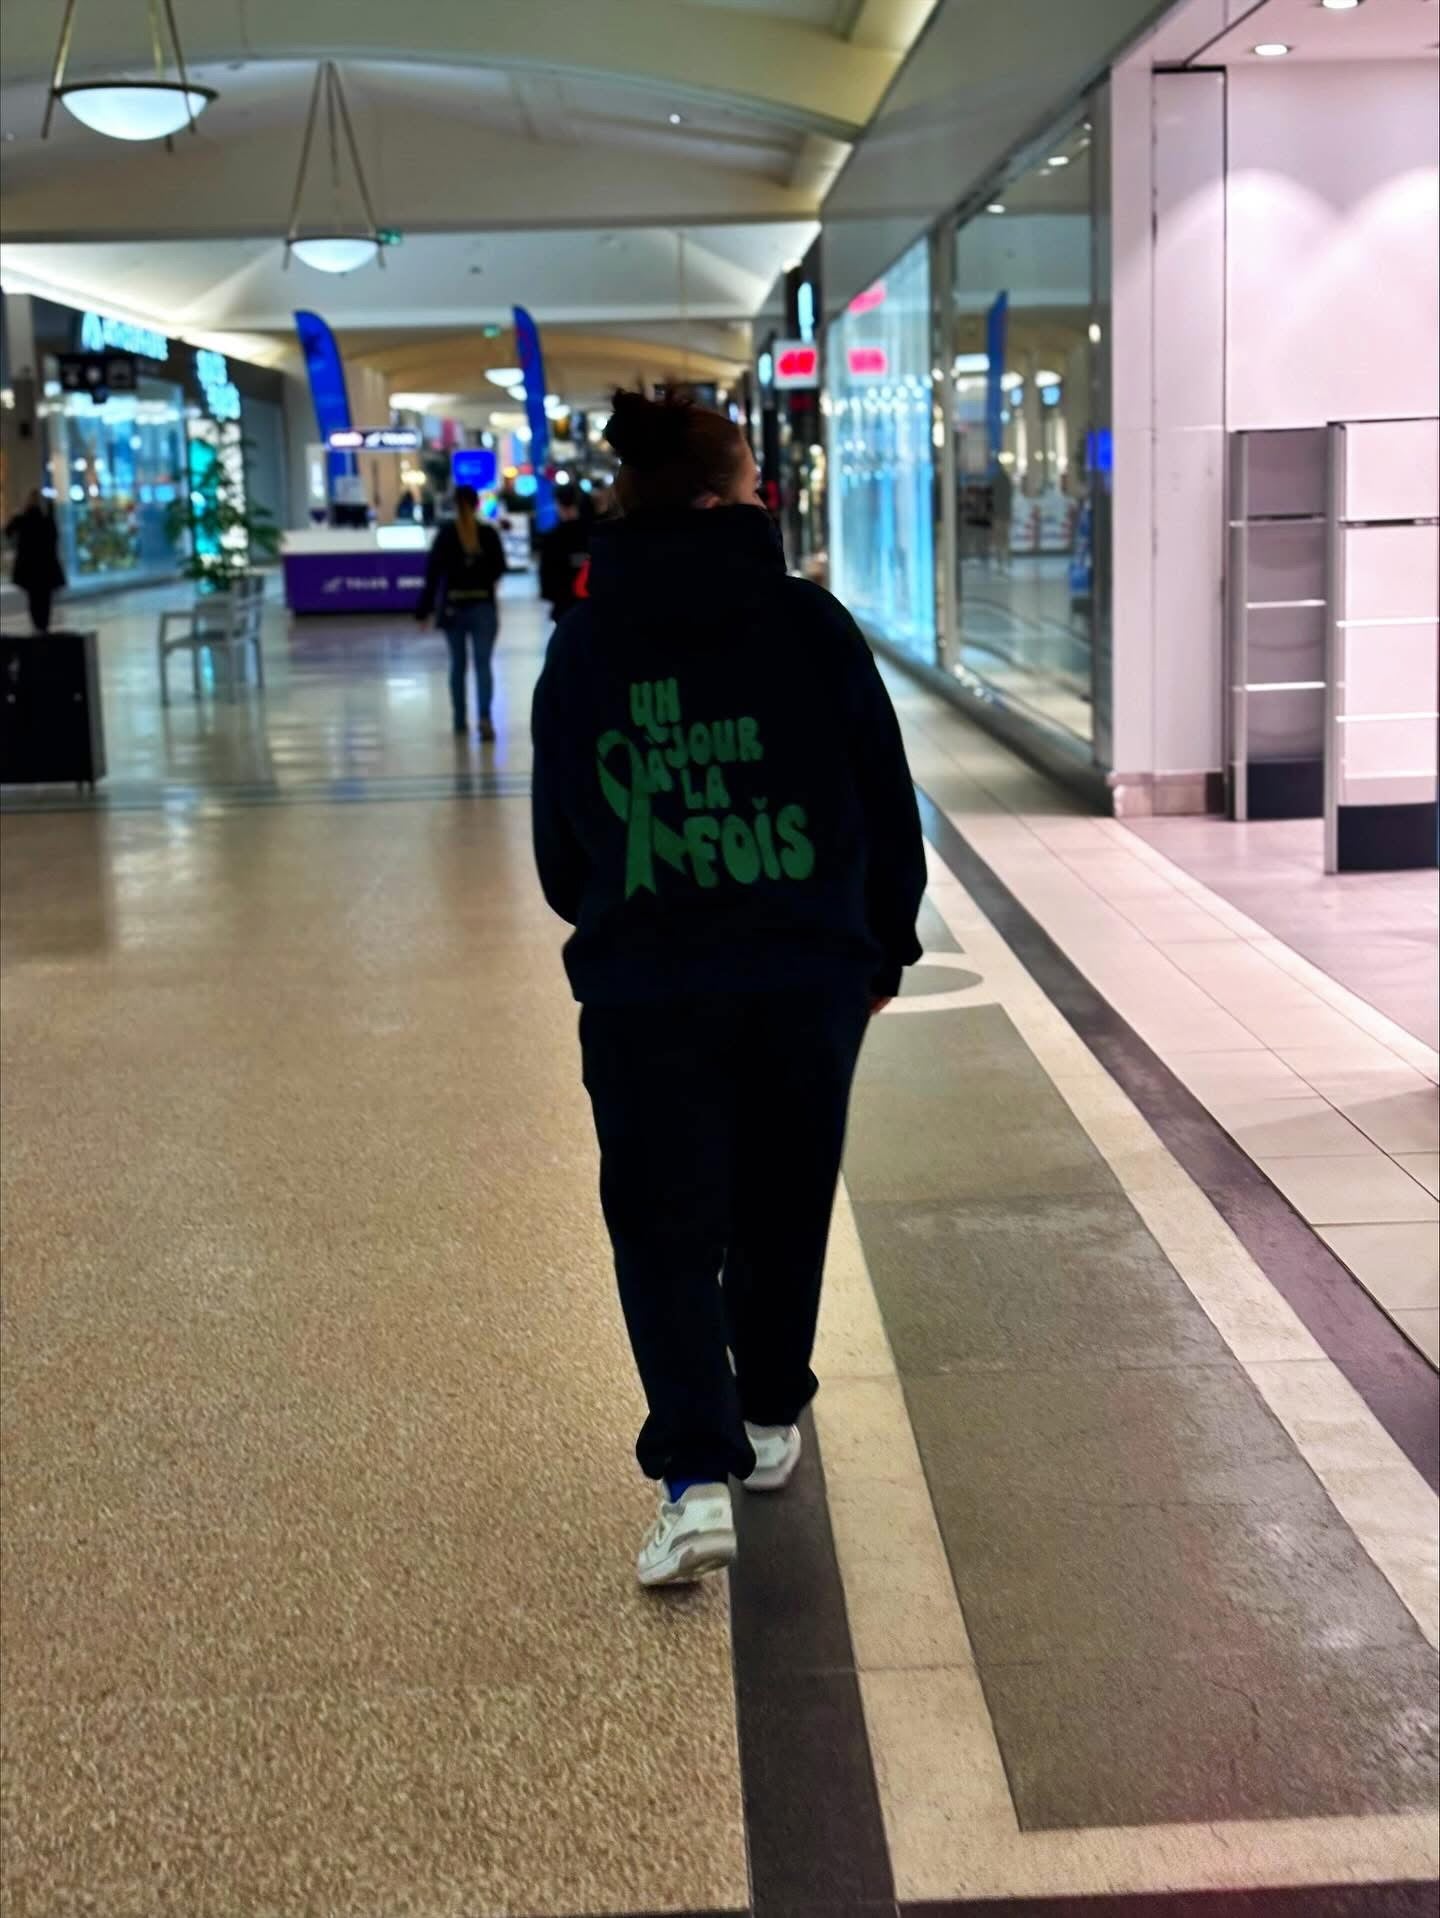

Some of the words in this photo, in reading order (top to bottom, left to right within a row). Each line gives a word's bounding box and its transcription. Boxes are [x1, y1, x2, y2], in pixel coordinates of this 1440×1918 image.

[629, 677, 681, 726] UN
[665, 716, 764, 769] JOUR
[680, 765, 731, 809] LA
